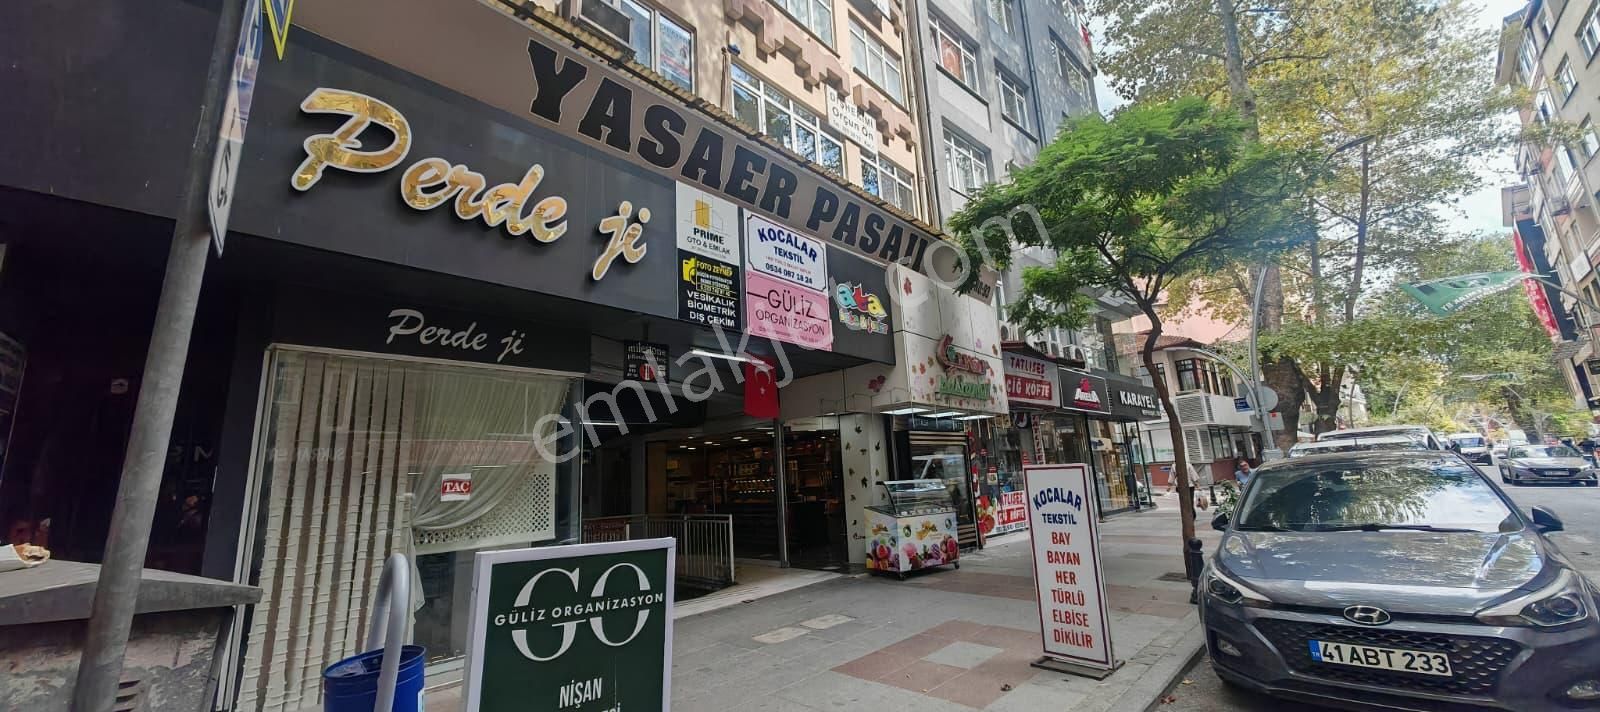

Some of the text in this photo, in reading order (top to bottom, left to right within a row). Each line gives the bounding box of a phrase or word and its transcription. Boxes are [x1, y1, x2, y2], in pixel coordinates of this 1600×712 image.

[528, 39, 798, 219] YASAER
[291, 87, 651, 281] Perde ji
[687, 236, 701, 247] OTO
[703, 241, 708, 249] &
[693, 228, 725, 245] PRIME
[757, 228, 817, 262] KOCALAR
[696, 261, 712, 272] FOTO
[687, 289, 735, 308] VESİKALIK
[767, 289, 815, 318] GÜLİZ
[687, 300, 736, 318] BİOMETRİK
[755, 309, 825, 335] ORGANİZASYON
[386, 308, 525, 362] Perde ji
[1120, 390, 1156, 409] KARAYEL
[443, 482, 471, 495] TAÇ
[1032, 487, 1083, 512] KOCALAR
[1042, 511, 1077, 525] TEKSTİL
[1051, 531, 1071, 545] BAY
[1046, 550, 1081, 566] BAYAN
[1055, 571, 1077, 585] HER
[1051, 588, 1085, 607] TÜRLÜ
[494, 593, 664, 626] GÜLİZ ORGANİZASYON
[512, 562, 651, 661] GO
[1052, 609, 1089, 628] ELBİSE
[1053, 628, 1093, 649] DİKİLİR
[1321, 643, 1344, 663] 41
[1349, 649, 1395, 669] ABT
[1402, 652, 1449, 674] 233
[559, 677, 603, 708] NİŞAN
